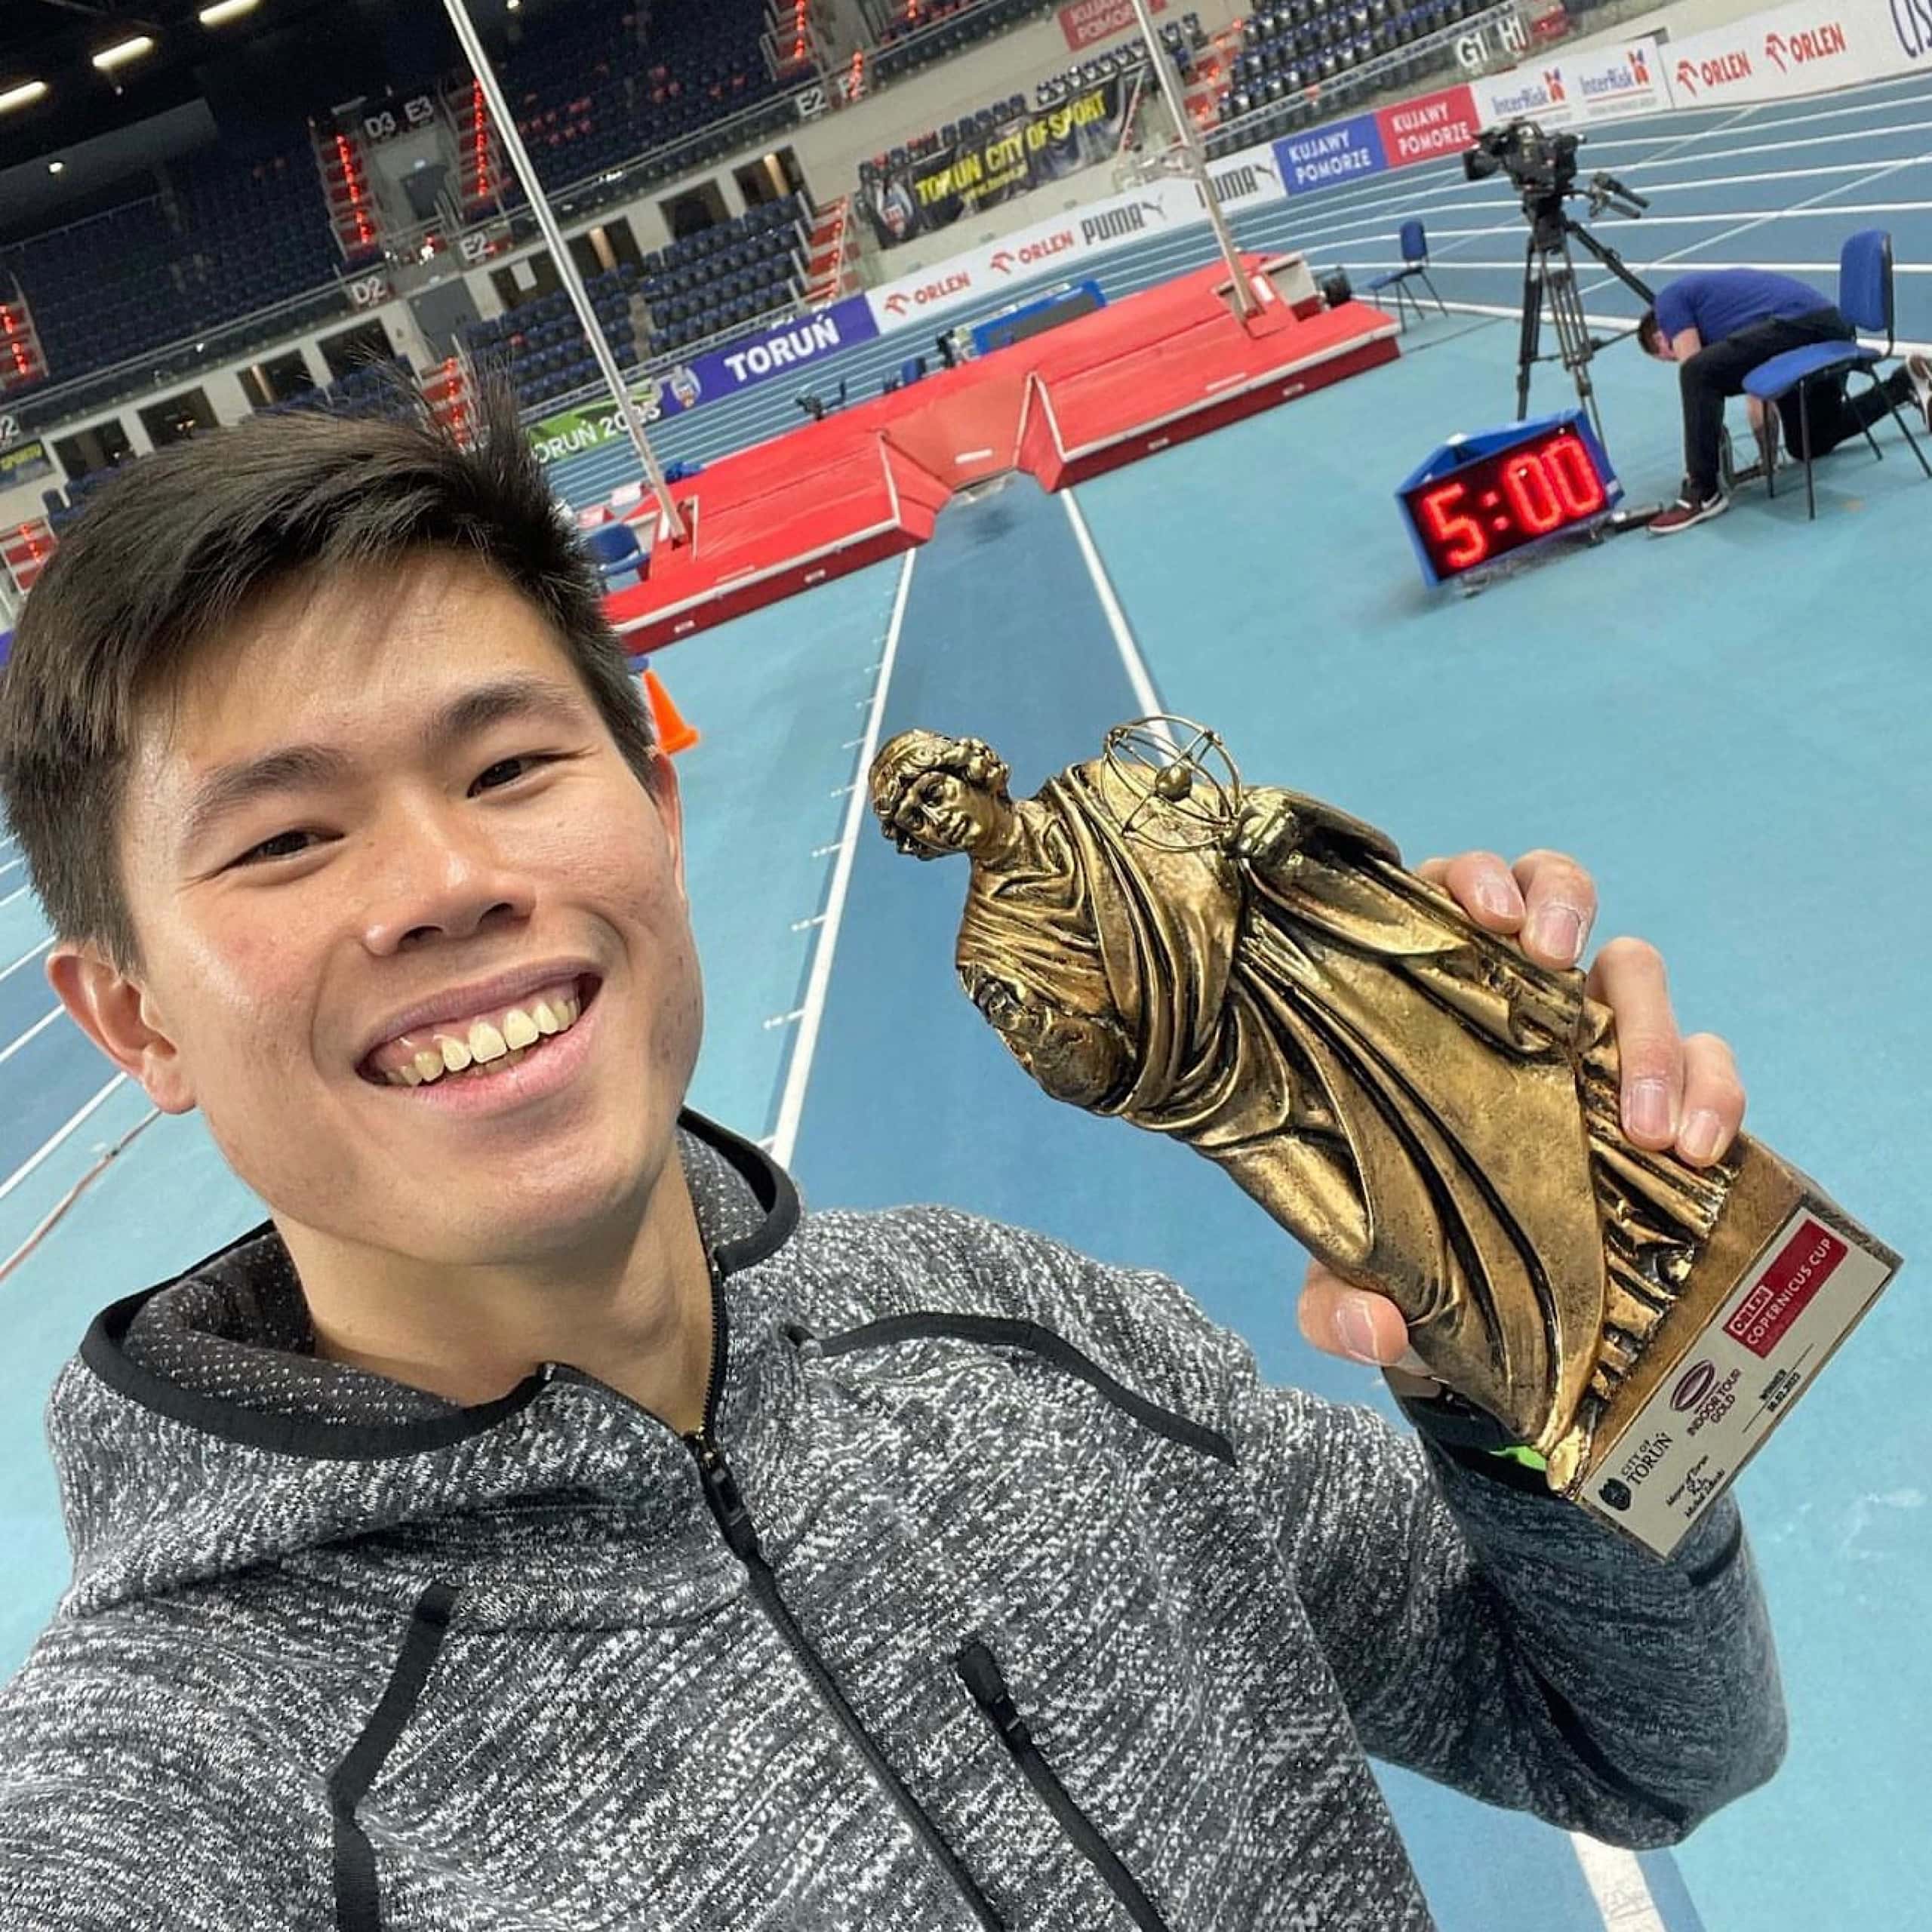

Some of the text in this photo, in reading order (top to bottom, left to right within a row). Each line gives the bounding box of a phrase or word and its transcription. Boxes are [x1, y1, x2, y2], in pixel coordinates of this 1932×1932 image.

[1456, 32, 1489, 69] G1
[1496, 15, 1529, 54] H1
[1789, 22, 1846, 64] ORLEN
[1580, 66, 1635, 95] InterRisk
[1700, 51, 1752, 88] ORLEN
[405, 96, 434, 122] E3
[795, 86, 827, 117] E2
[1392, 103, 1448, 133] KUJAWY
[364, 112, 395, 138] D3
[986, 132, 1024, 171] CITY
[1026, 122, 1050, 150] OF
[1048, 90, 1106, 140] SPORT
[1398, 122, 1472, 156] POMORZE
[1288, 130, 1349, 163] KUJAWY
[1295, 148, 1372, 185] POMORZE
[1081, 203, 1146, 246] PUMA
[460, 232, 492, 260] E2
[1017, 230, 1075, 264] ORLEN
[351, 275, 386, 304] D2
[914, 272, 971, 306] ORLEN
[724, 313, 841, 383] TORUŃ
[531, 420, 598, 463] ORUŃ
[1422, 436, 1603, 568] 5:00
[1746, 1238, 1831, 1344] COPERNICUS CUP
[1686, 1395, 1721, 1436] INDOOR
[1715, 1368, 1741, 1396] TOUR
[1710, 1394, 1735, 1423] GOLD
[1621, 1438, 1651, 1476] CITY OF
[1626, 1431, 1673, 1485] TORUŃ
